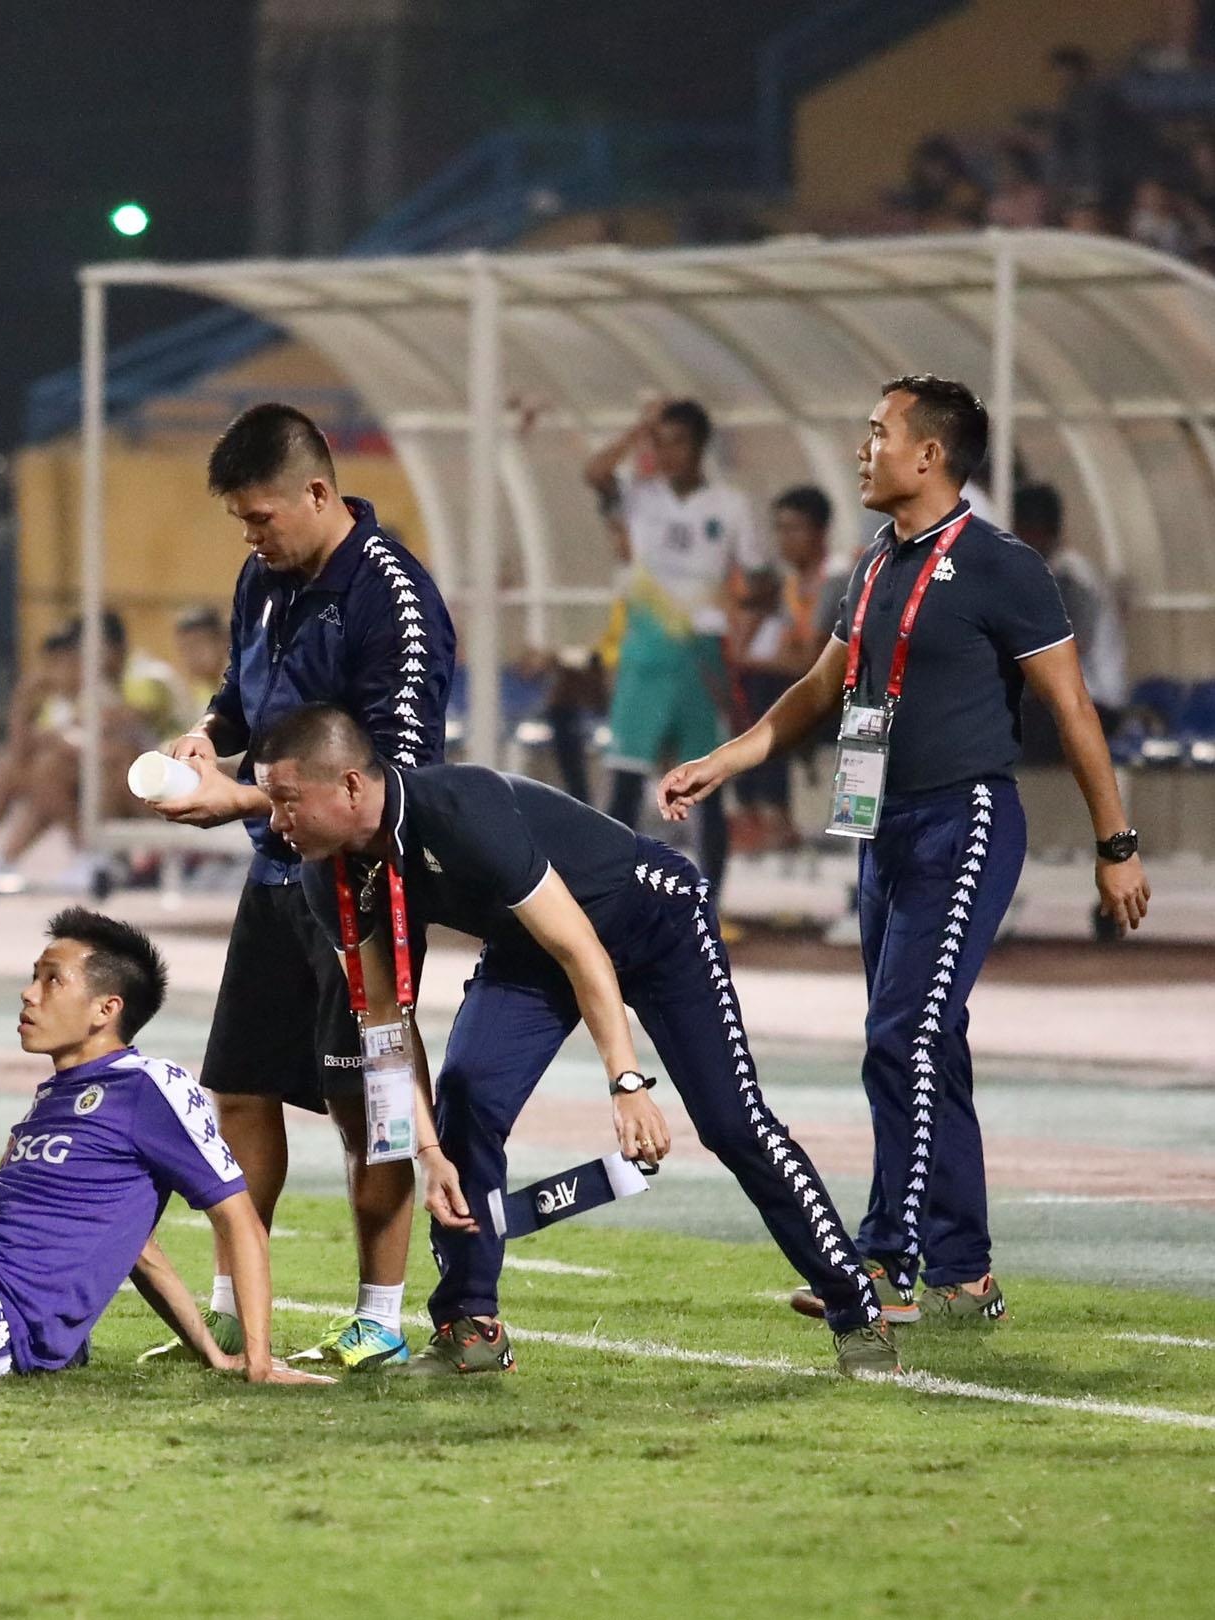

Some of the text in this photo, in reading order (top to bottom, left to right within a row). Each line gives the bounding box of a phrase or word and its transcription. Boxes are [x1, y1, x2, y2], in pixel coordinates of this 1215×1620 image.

[931, 570, 953, 581] appa
[324, 1054, 364, 1068] Kapp
[10, 1134, 73, 1164] SCG
[537, 1177, 578, 1214] AFC
